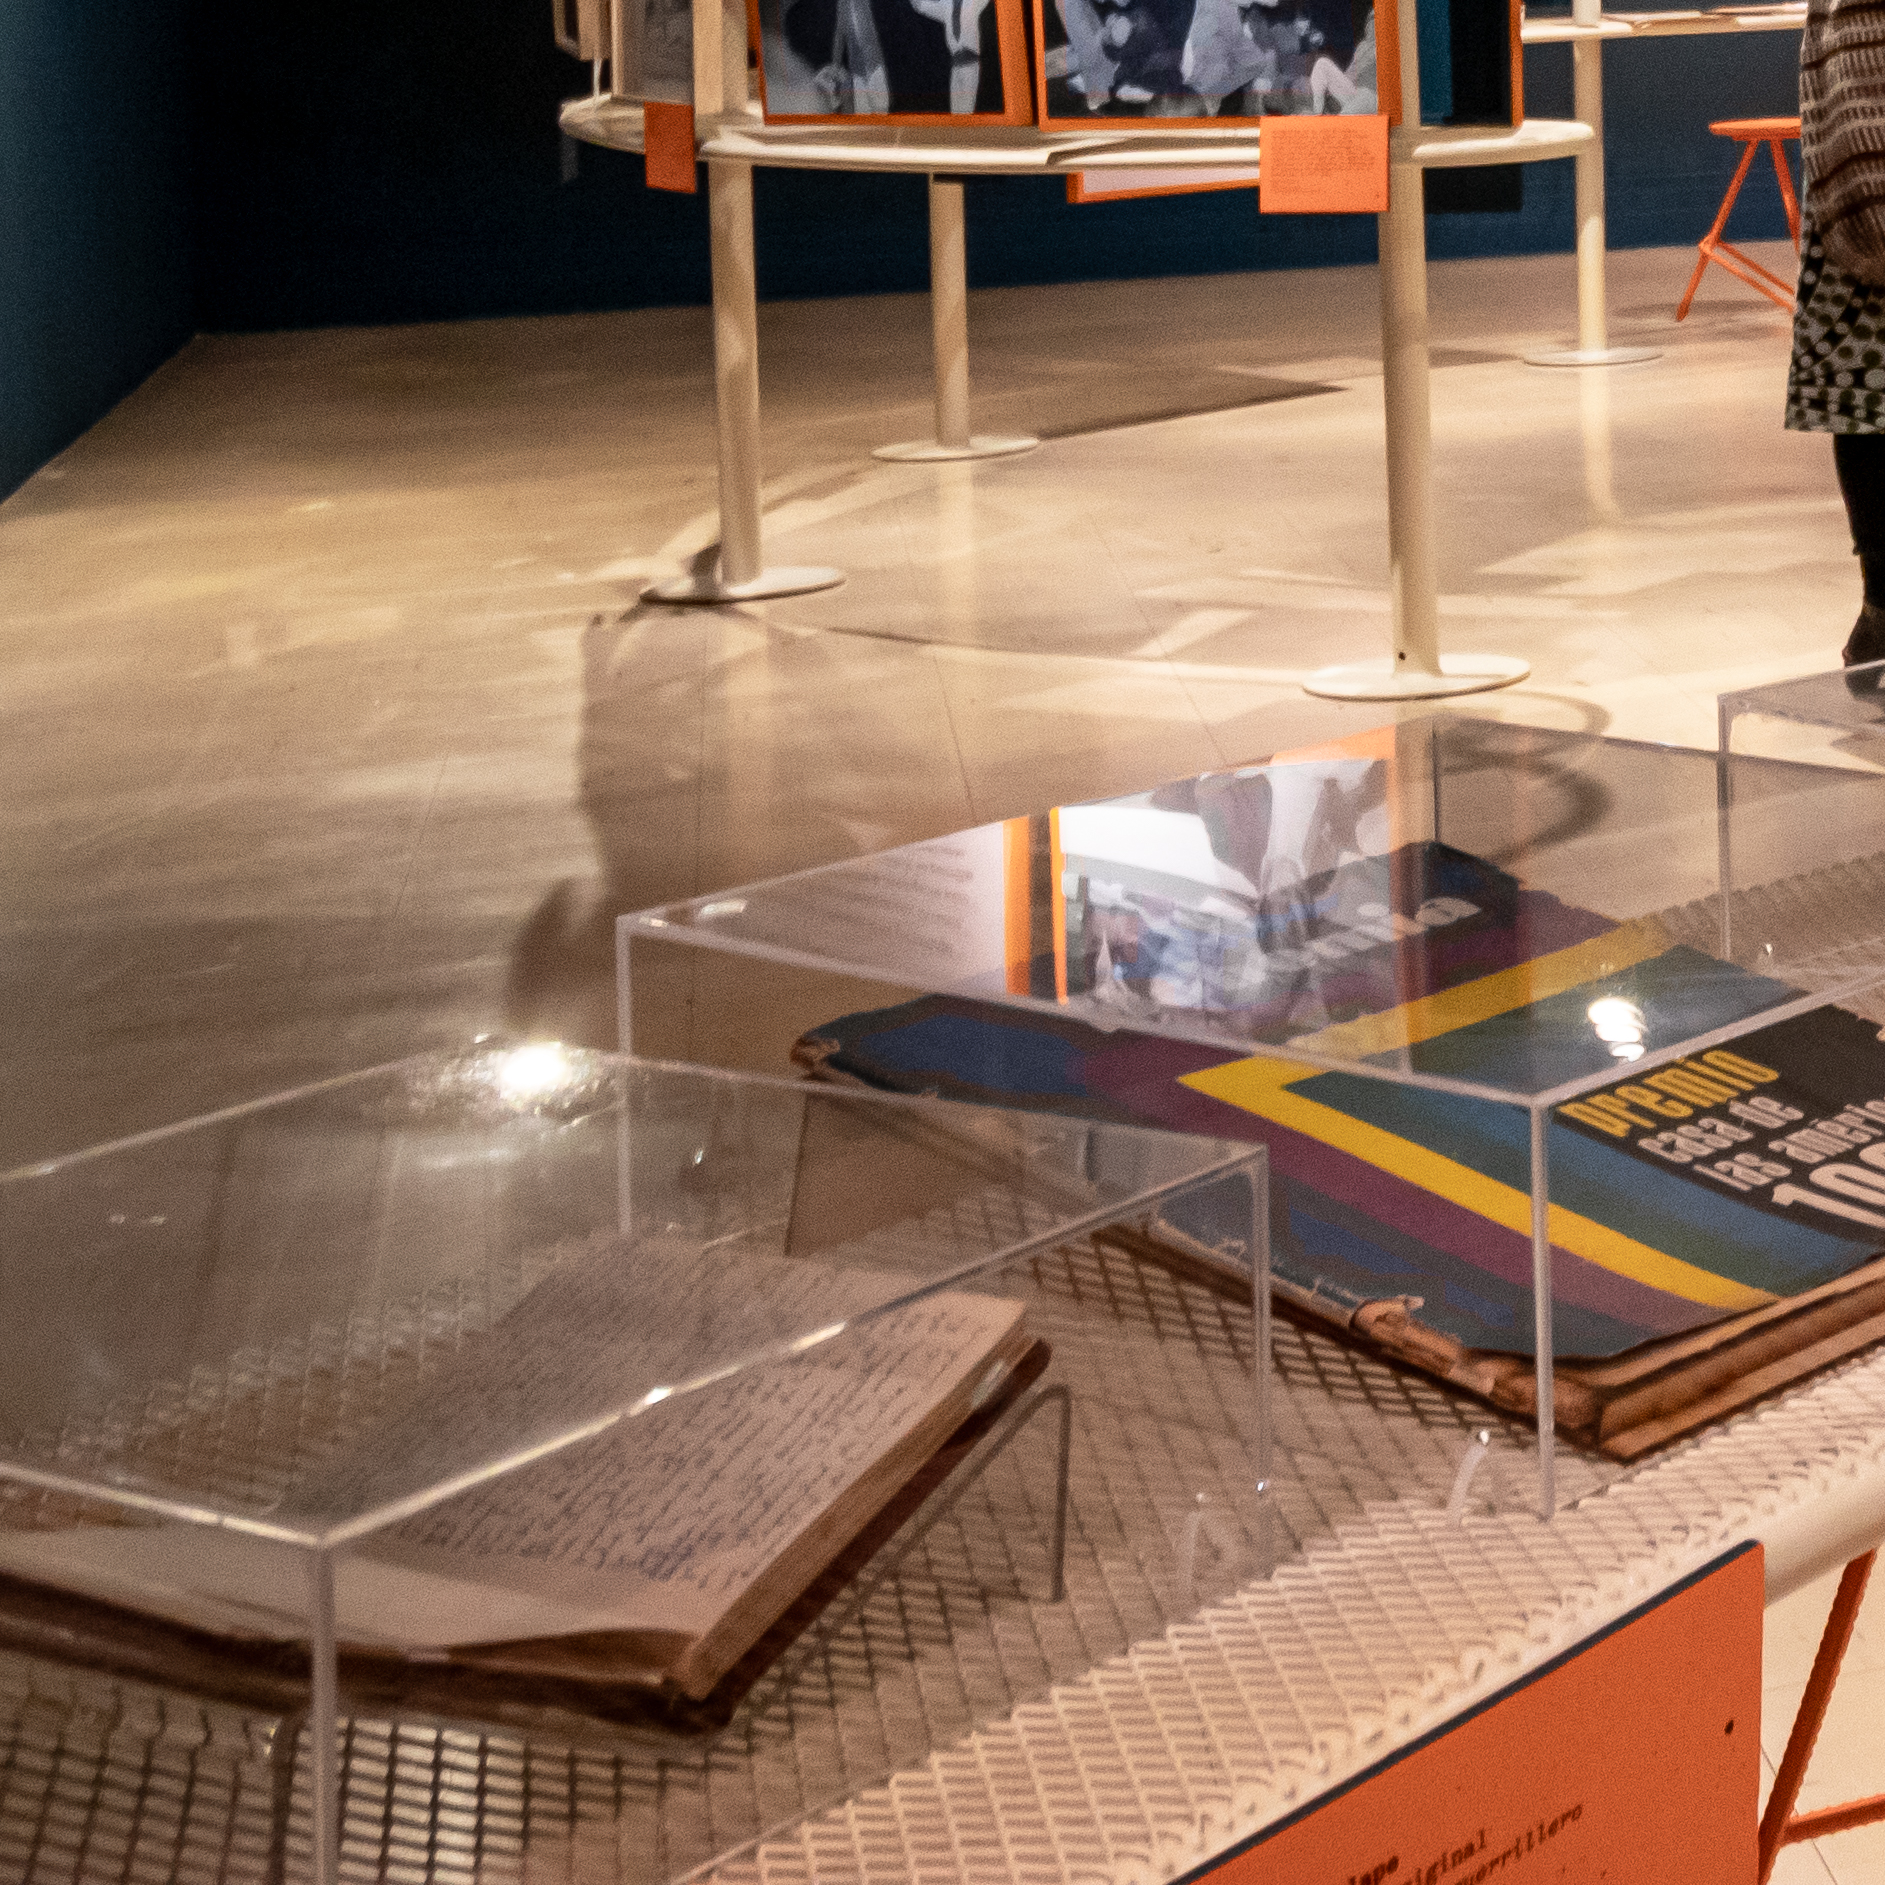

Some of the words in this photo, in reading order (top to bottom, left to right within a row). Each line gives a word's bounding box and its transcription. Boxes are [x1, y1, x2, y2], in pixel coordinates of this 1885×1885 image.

[1558, 1048, 1780, 1139] premio
[1636, 1116, 1754, 1165] casa
[1728, 1095, 1805, 1130] de
[1693, 1150, 1793, 1193] las
